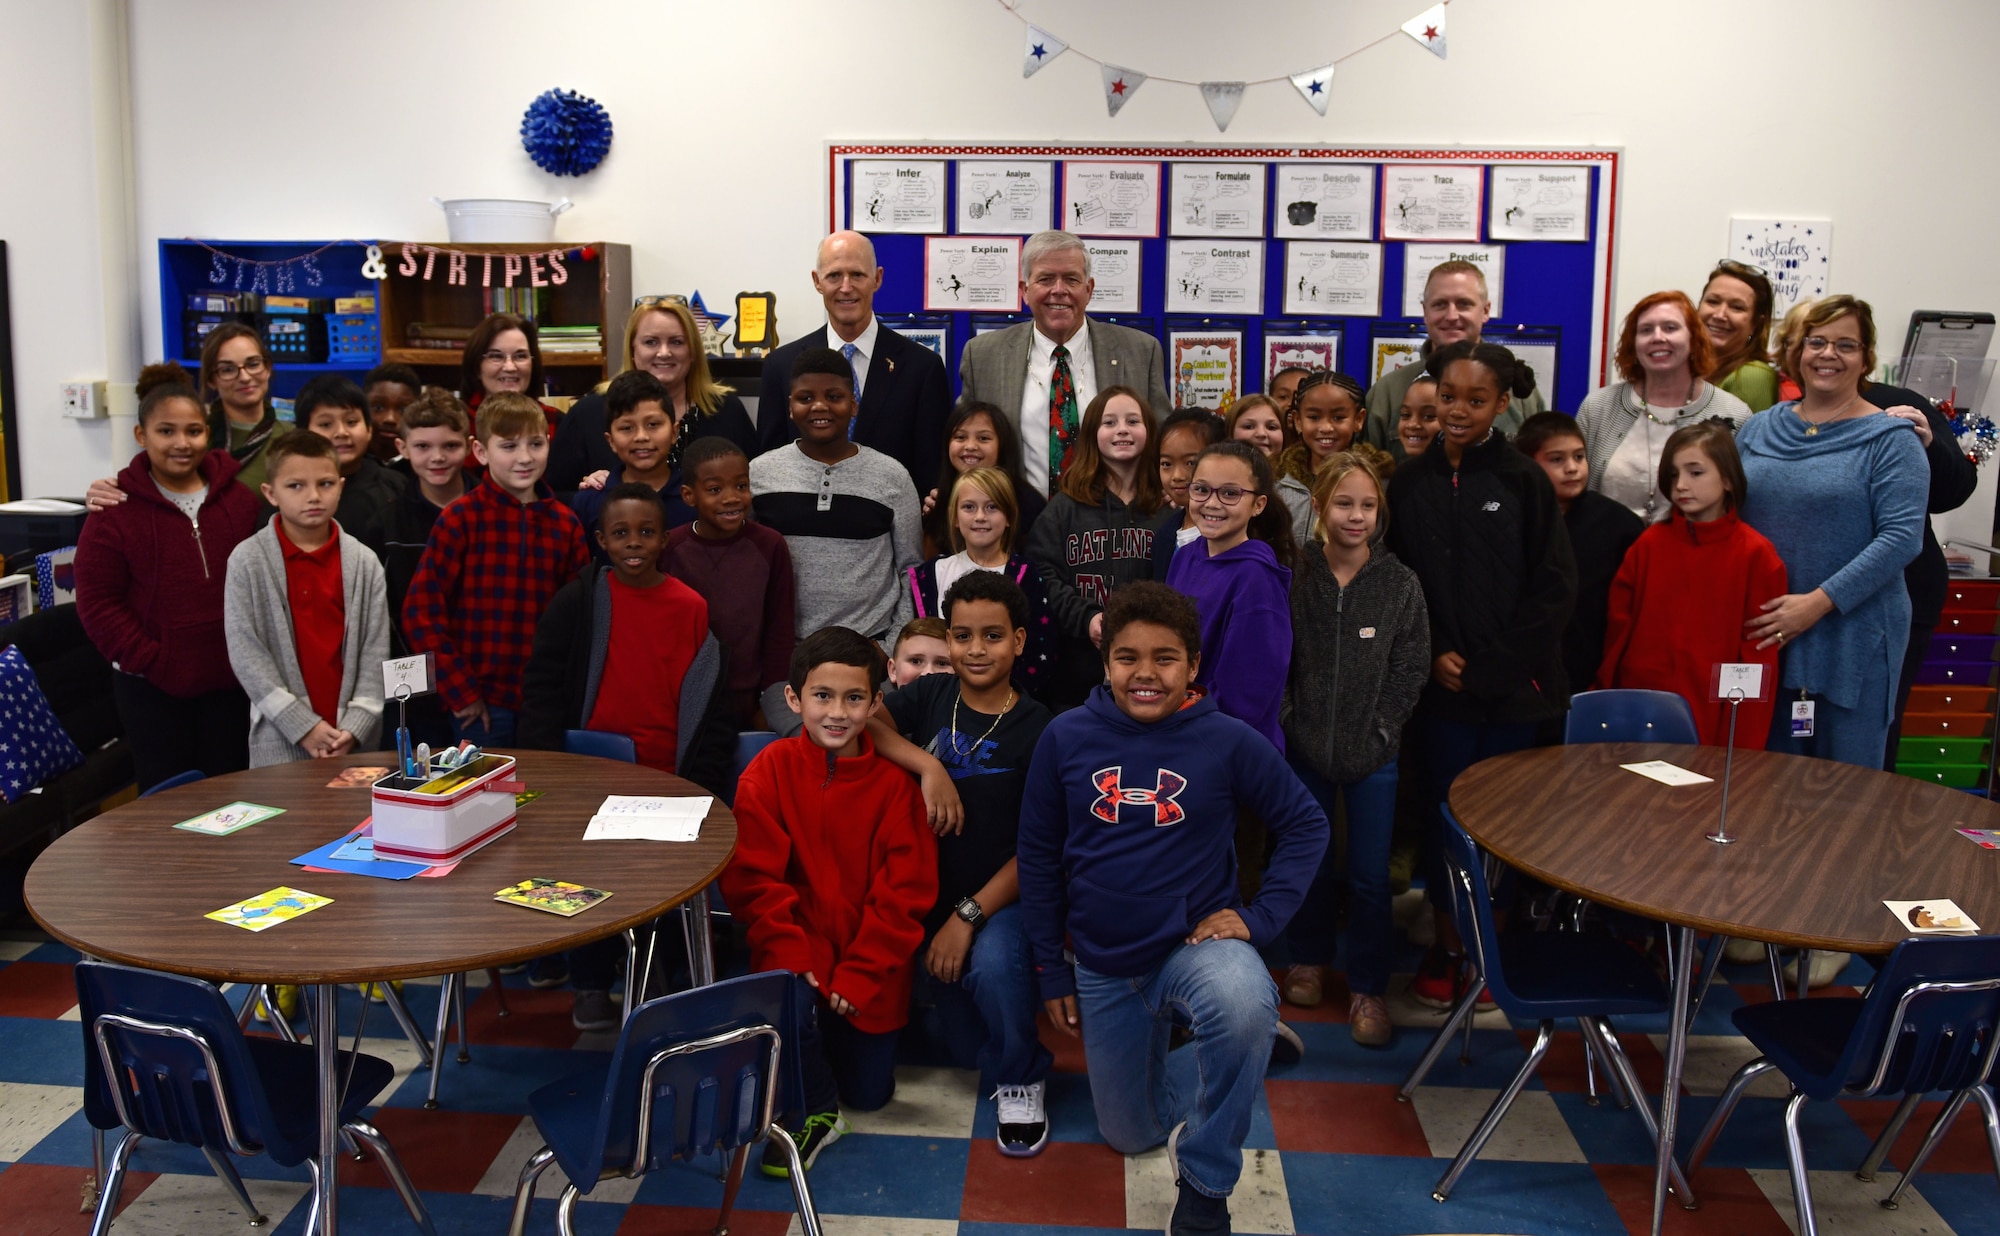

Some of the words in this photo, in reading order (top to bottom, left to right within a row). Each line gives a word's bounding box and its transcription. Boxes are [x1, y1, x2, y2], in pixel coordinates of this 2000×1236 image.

[896, 168, 922, 178] Infer
[1006, 170, 1031, 179] Analyze
[1110, 170, 1144, 180] Evaluate
[1216, 171, 1250, 181] Formulate
[1323, 173, 1361, 183] Describe
[1434, 175, 1454, 184] Trace
[1538, 174, 1576, 183] Support
[971, 245, 1008, 255] Explain
[1089, 247, 1128, 256] Compare
[1211, 248, 1250, 258] Contrast
[1750, 237, 1809, 261] mistakes
[1330, 249, 1369, 260] Summarize
[1449, 252, 1489, 262] Predict
[361, 245, 388, 280] &
[398, 242, 568, 287] STRIPES
[392, 660, 417, 672] TABLE
